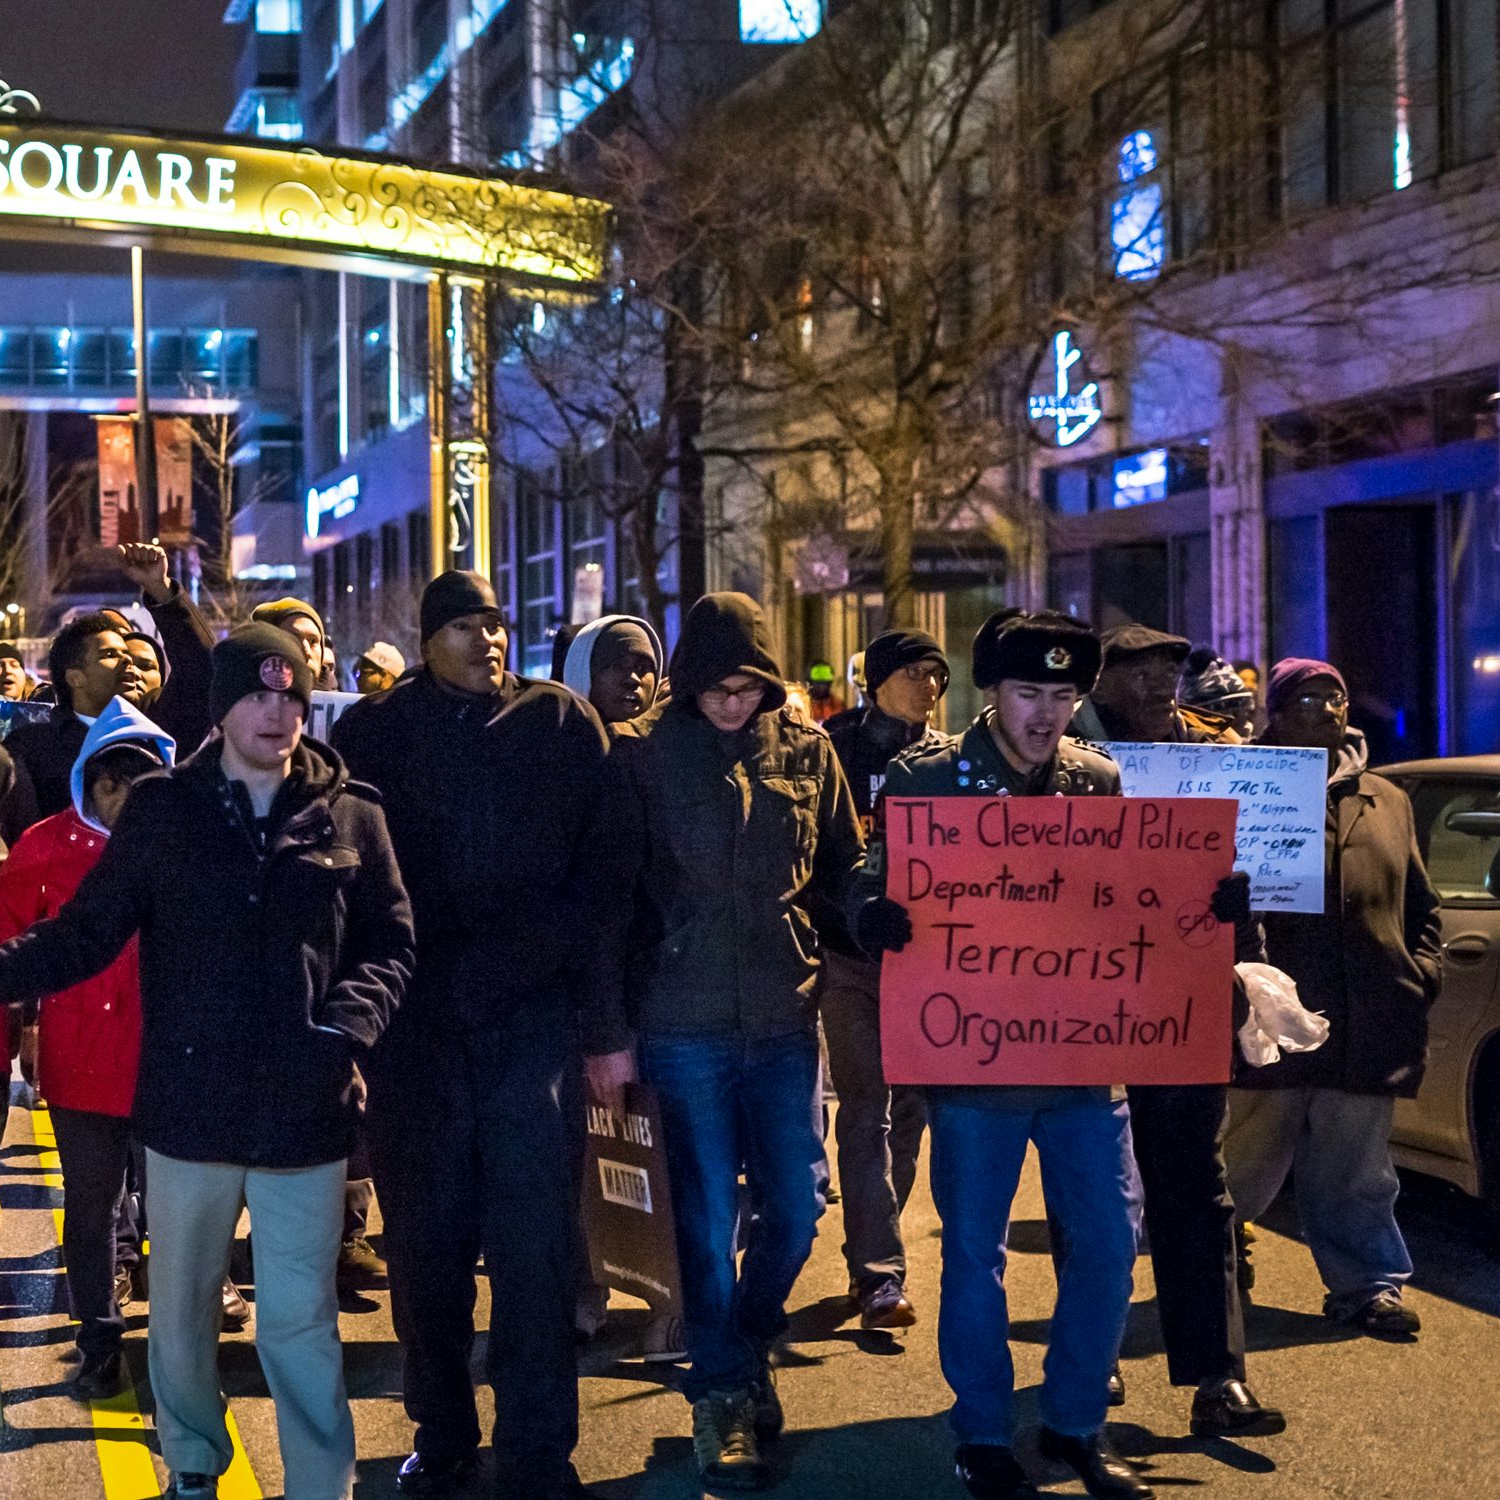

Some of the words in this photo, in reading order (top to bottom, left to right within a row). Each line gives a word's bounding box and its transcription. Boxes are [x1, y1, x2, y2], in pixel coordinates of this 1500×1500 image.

[1117, 754, 1150, 774] AR
[1180, 755, 1203, 773] OF
[892, 801, 961, 846] The
[976, 801, 1127, 850] Cleveland
[1138, 803, 1222, 851] Police
[907, 857, 1065, 912] Department
[1093, 880, 1115, 908] is
[1137, 887, 1161, 908] a
[930, 923, 1155, 983] Terrorist
[920, 992, 1193, 1066] Organization!
[586, 1105, 616, 1138] LACK
[622, 1113, 653, 1148] LIVES
[603, 1166, 646, 1204] MATTER
